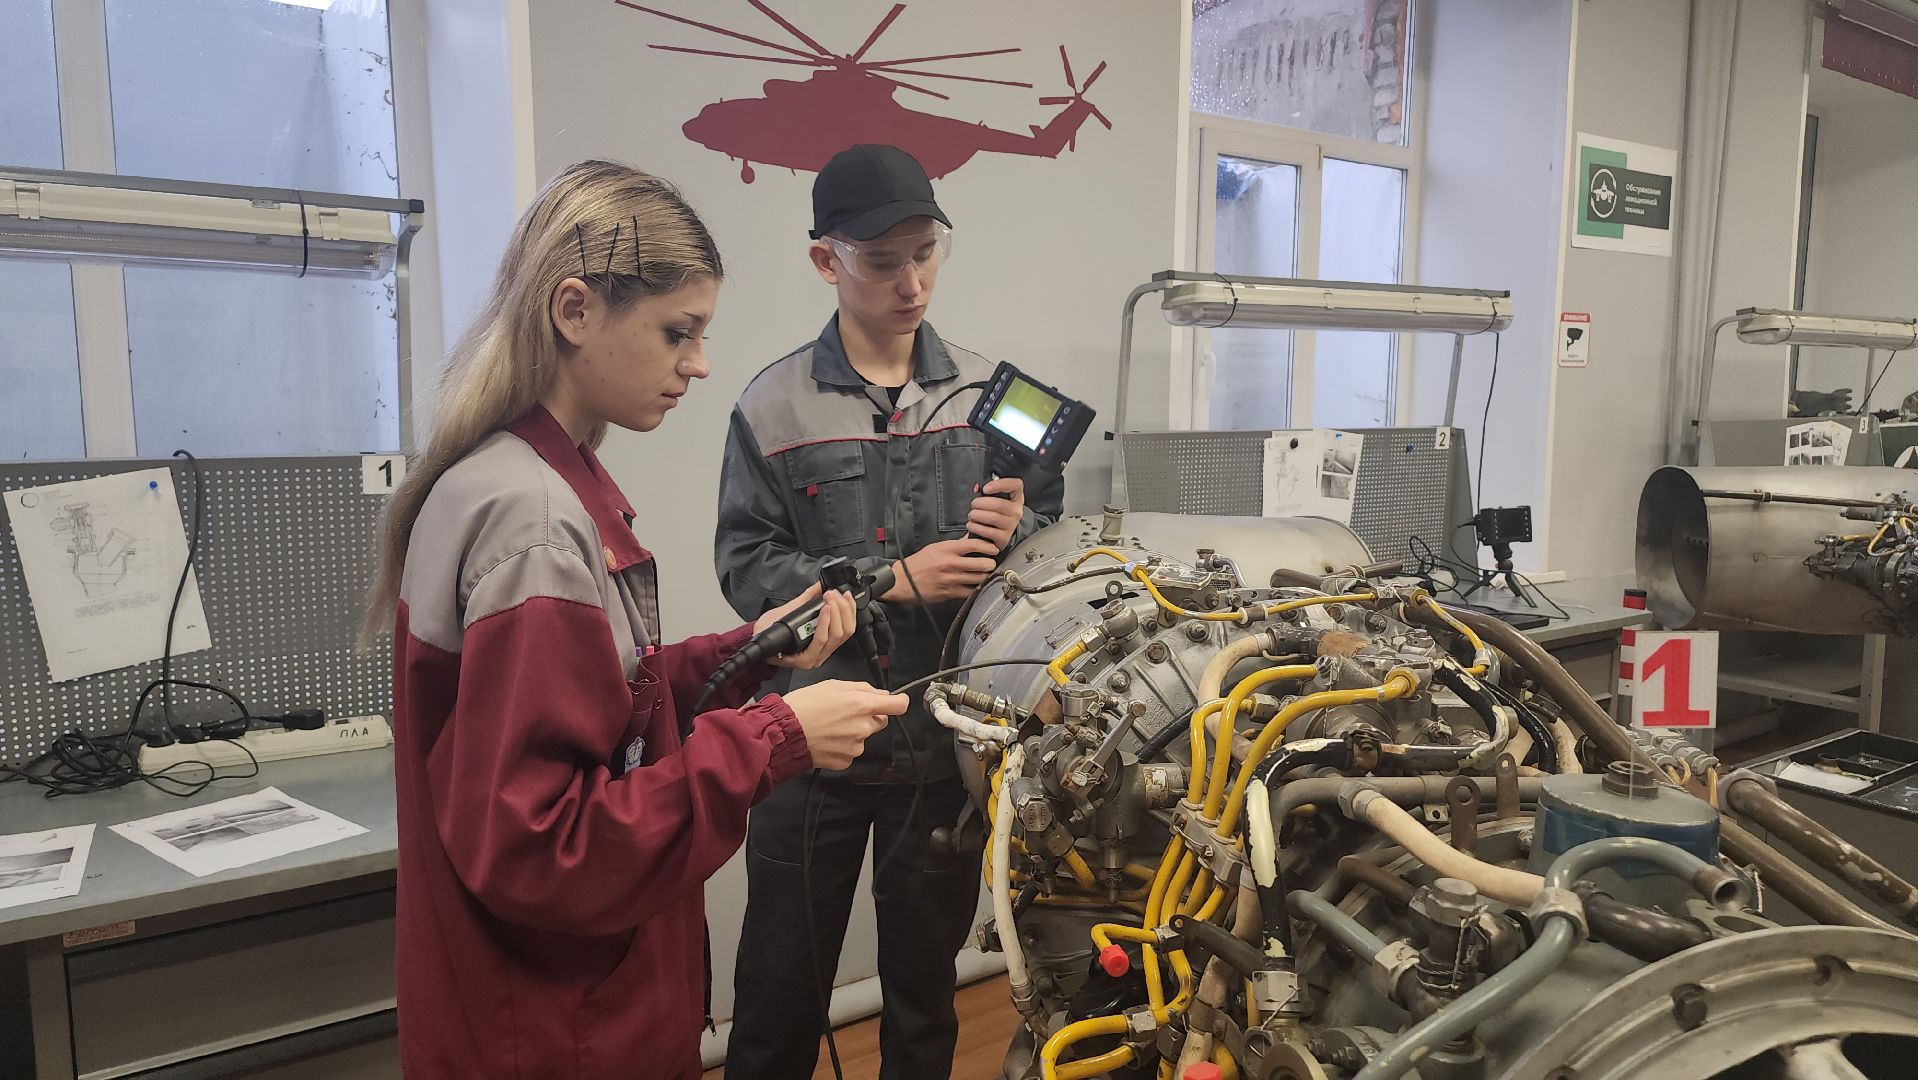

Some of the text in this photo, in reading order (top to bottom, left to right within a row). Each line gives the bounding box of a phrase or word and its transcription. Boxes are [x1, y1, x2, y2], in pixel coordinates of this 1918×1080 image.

[1439, 431, 1446, 447] 2
[378, 459, 392, 488] 1
[1641, 638, 1710, 727] 1
